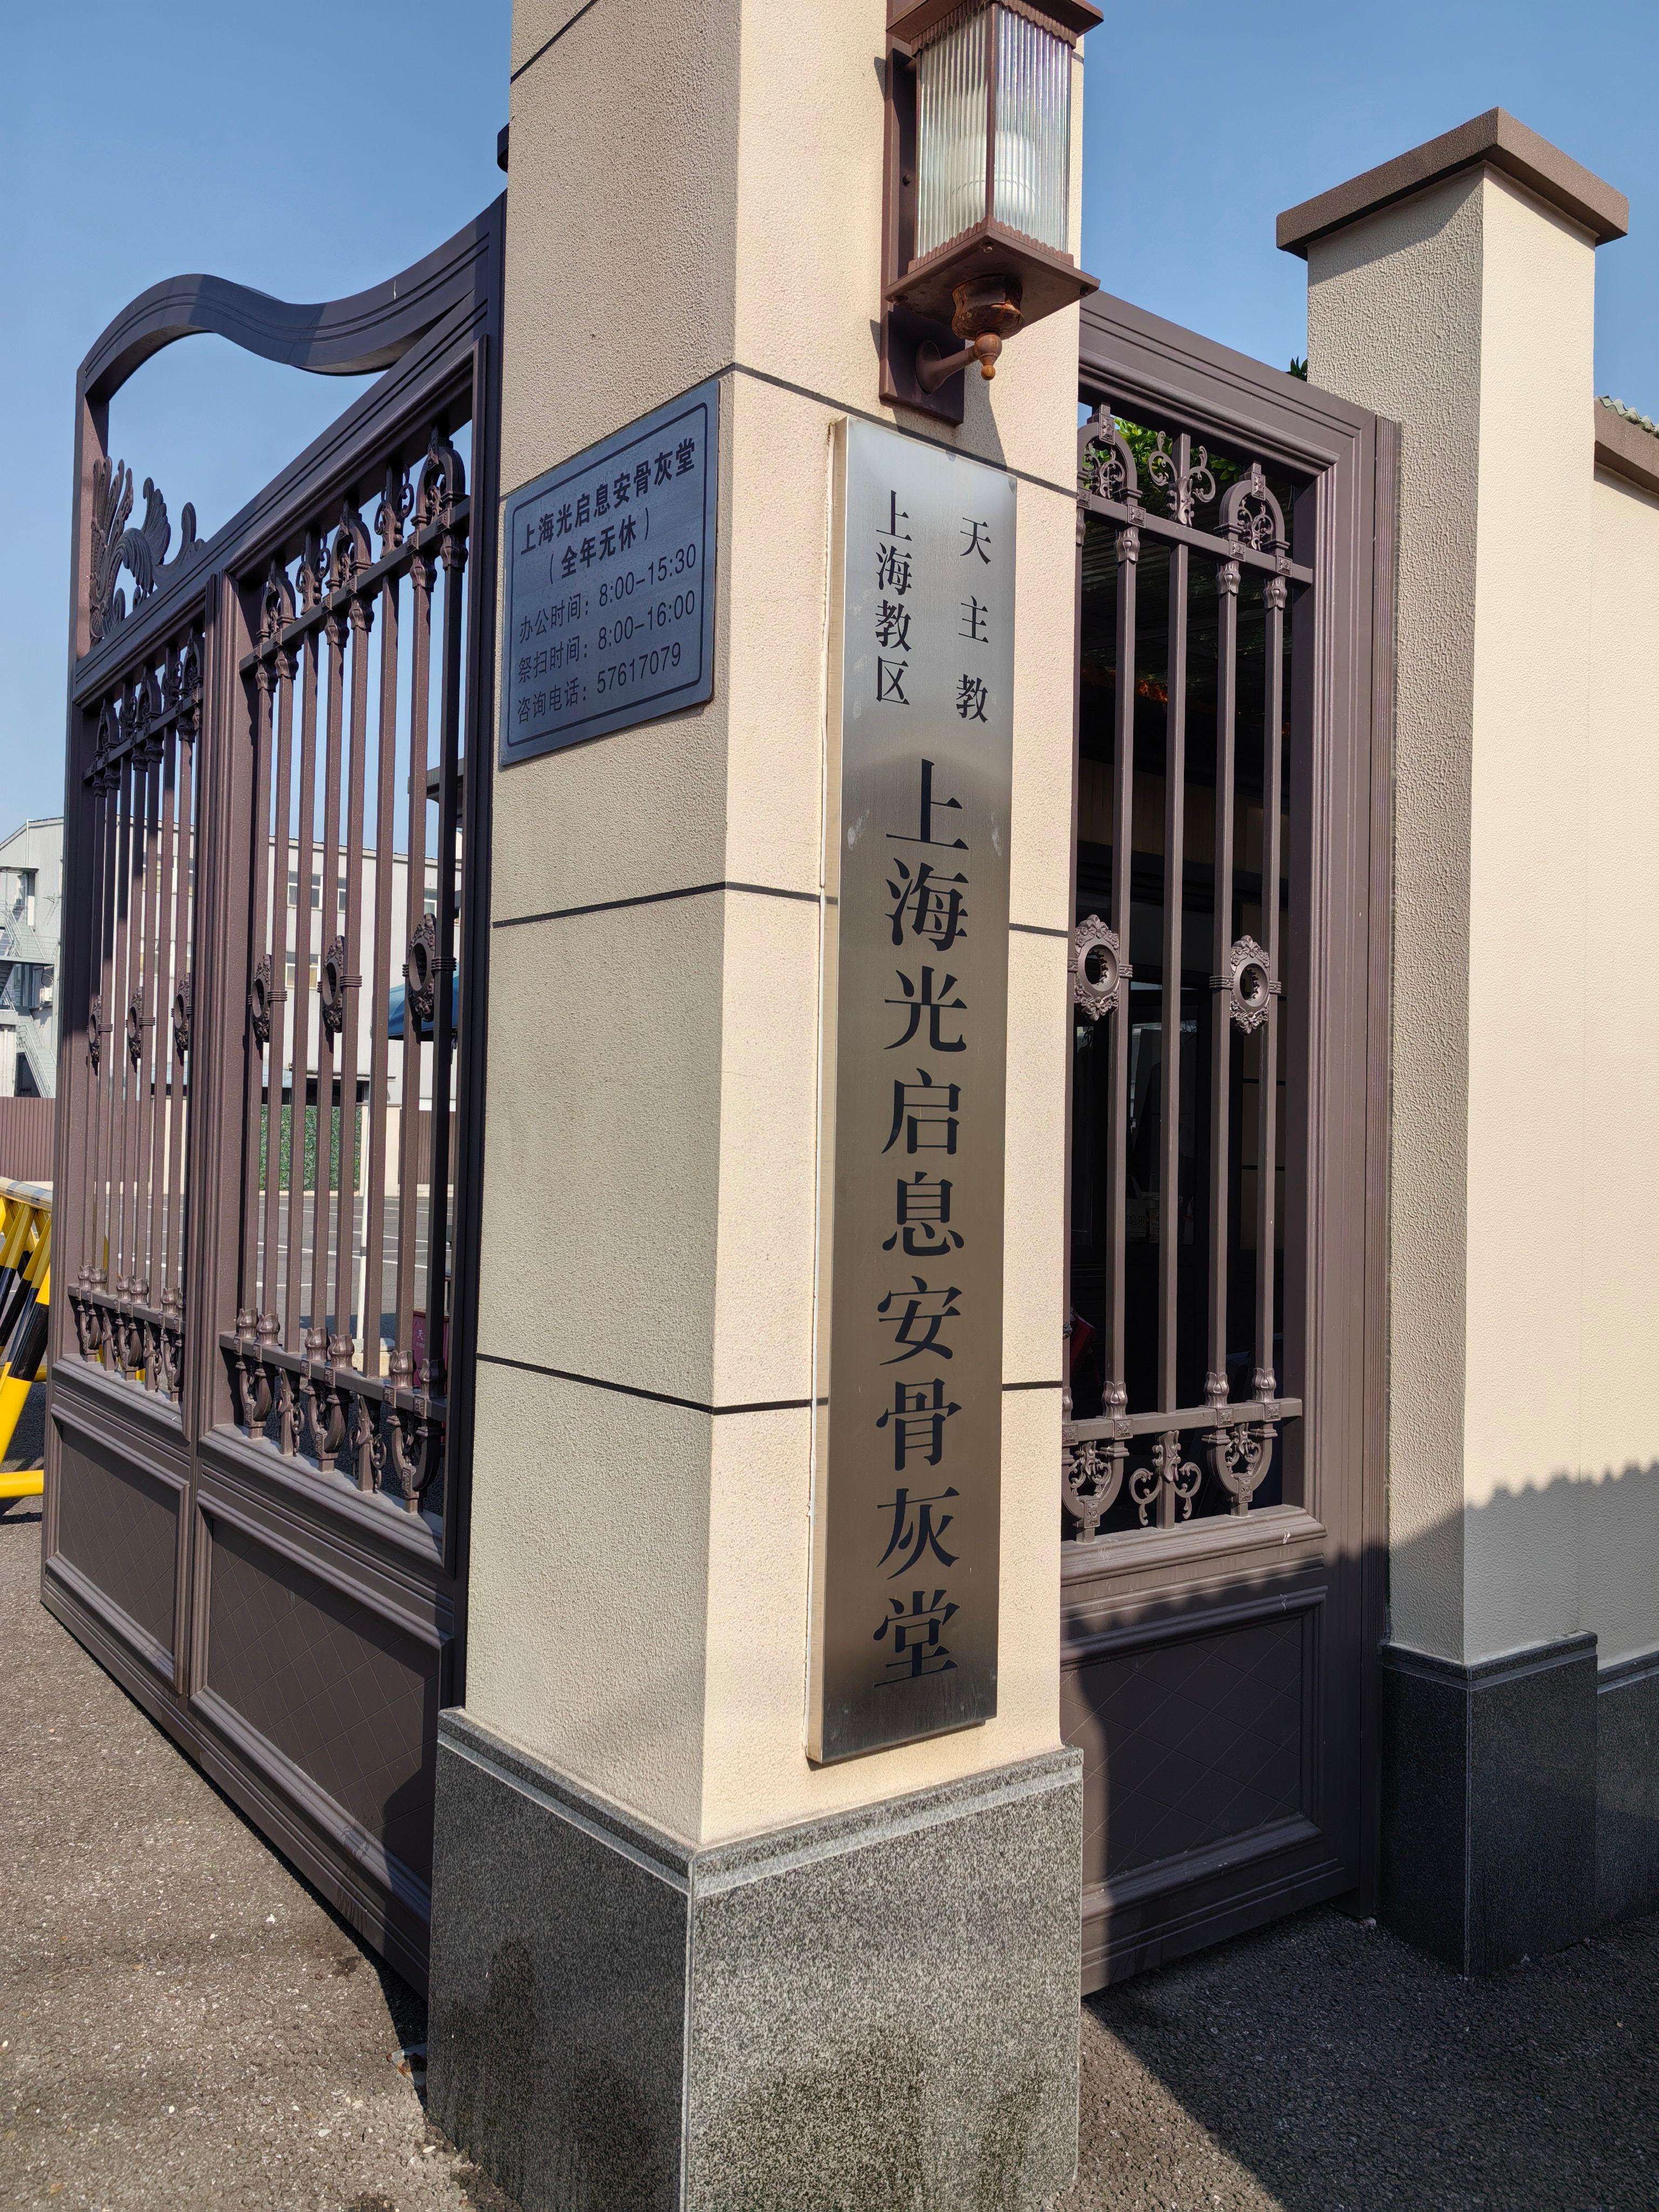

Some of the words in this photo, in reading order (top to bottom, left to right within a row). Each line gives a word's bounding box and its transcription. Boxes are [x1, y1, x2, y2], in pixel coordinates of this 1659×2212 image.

[520, 437, 695, 555] 上海光启息安骨灰堂
[875, 489, 912, 706] 上海教区
[955, 516, 992, 723] 天主教
[873, 758, 970, 1690] 上海光启息安骨灰堂
